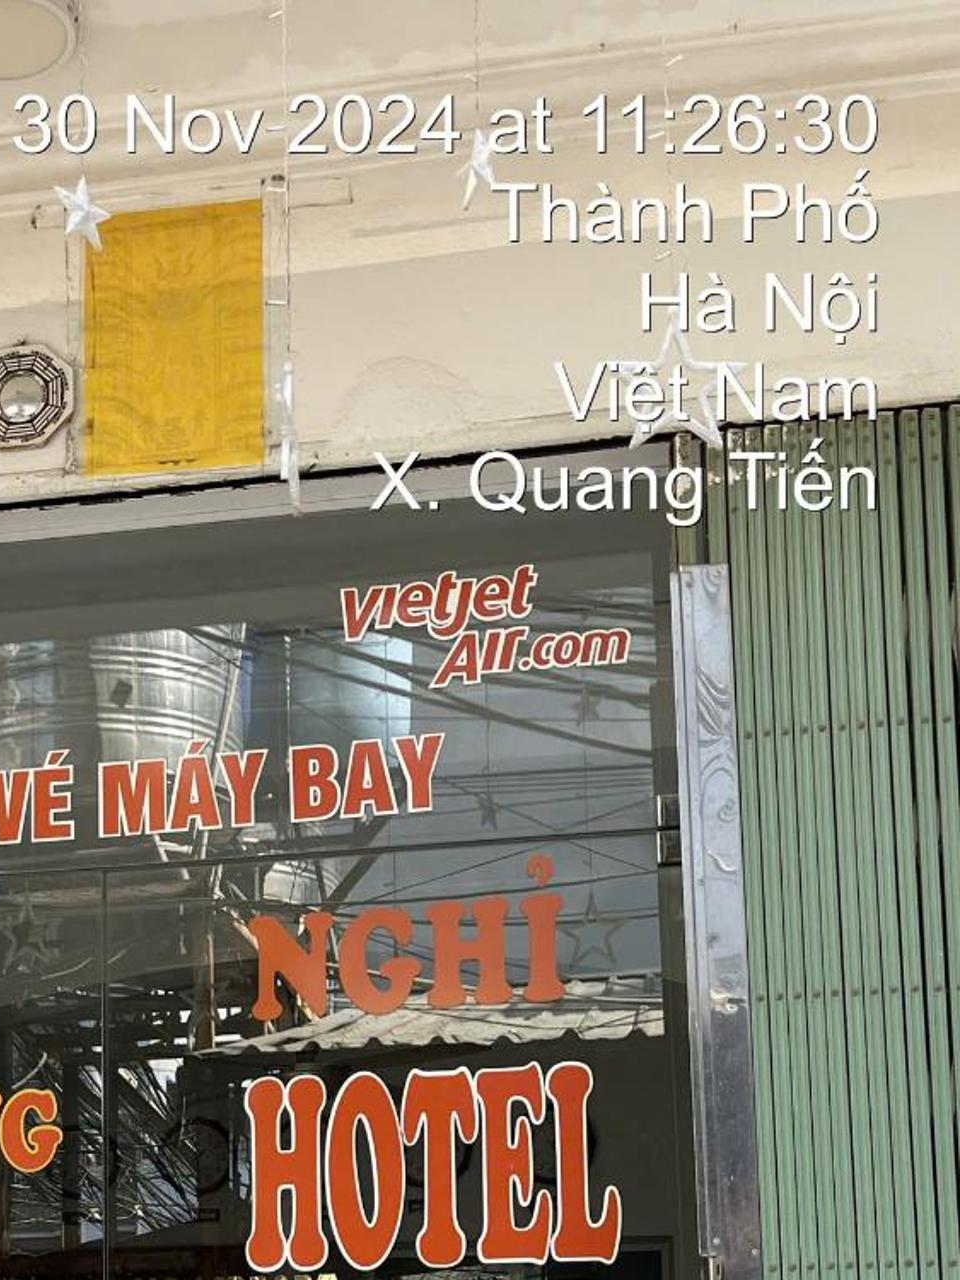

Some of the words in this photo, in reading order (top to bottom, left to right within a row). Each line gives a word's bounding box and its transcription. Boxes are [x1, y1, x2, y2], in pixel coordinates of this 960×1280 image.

[97, 738, 268, 838] MÁY
[288, 732, 445, 824] BAY
[246, 853, 566, 1022] NGHỈ
[243, 1060, 623, 1274] HOTEL
